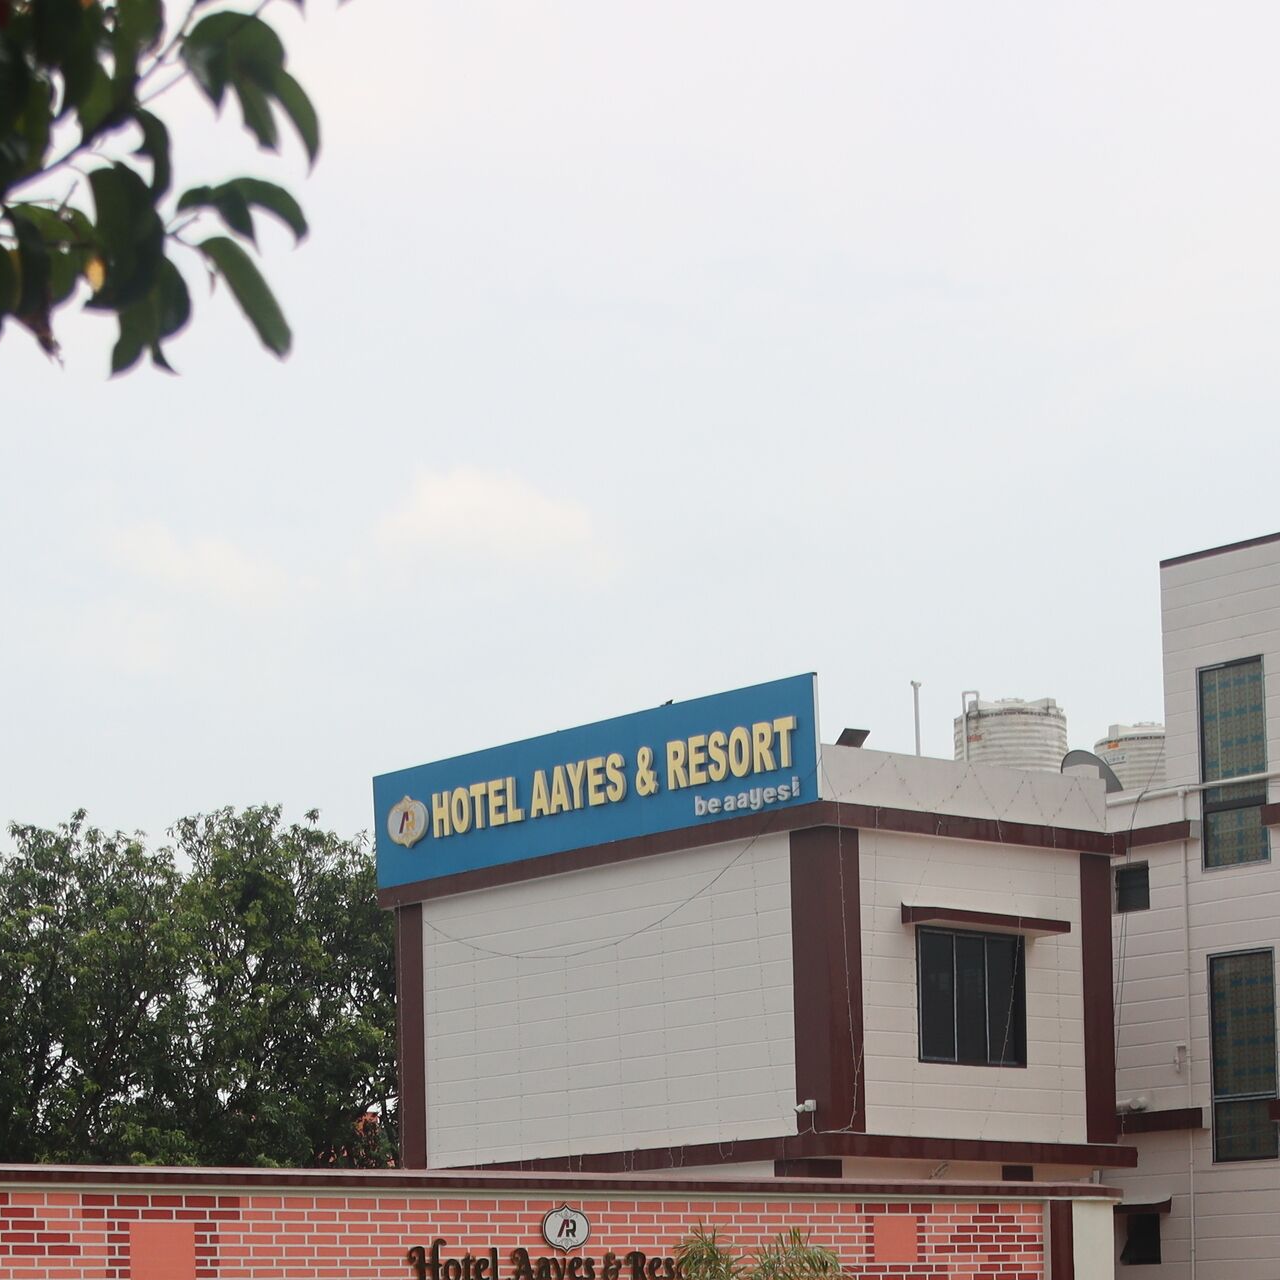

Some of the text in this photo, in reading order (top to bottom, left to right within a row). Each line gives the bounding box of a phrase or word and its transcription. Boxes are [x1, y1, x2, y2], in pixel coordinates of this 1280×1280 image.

[431, 715, 797, 839] HOTEL AAYES & RESORT
